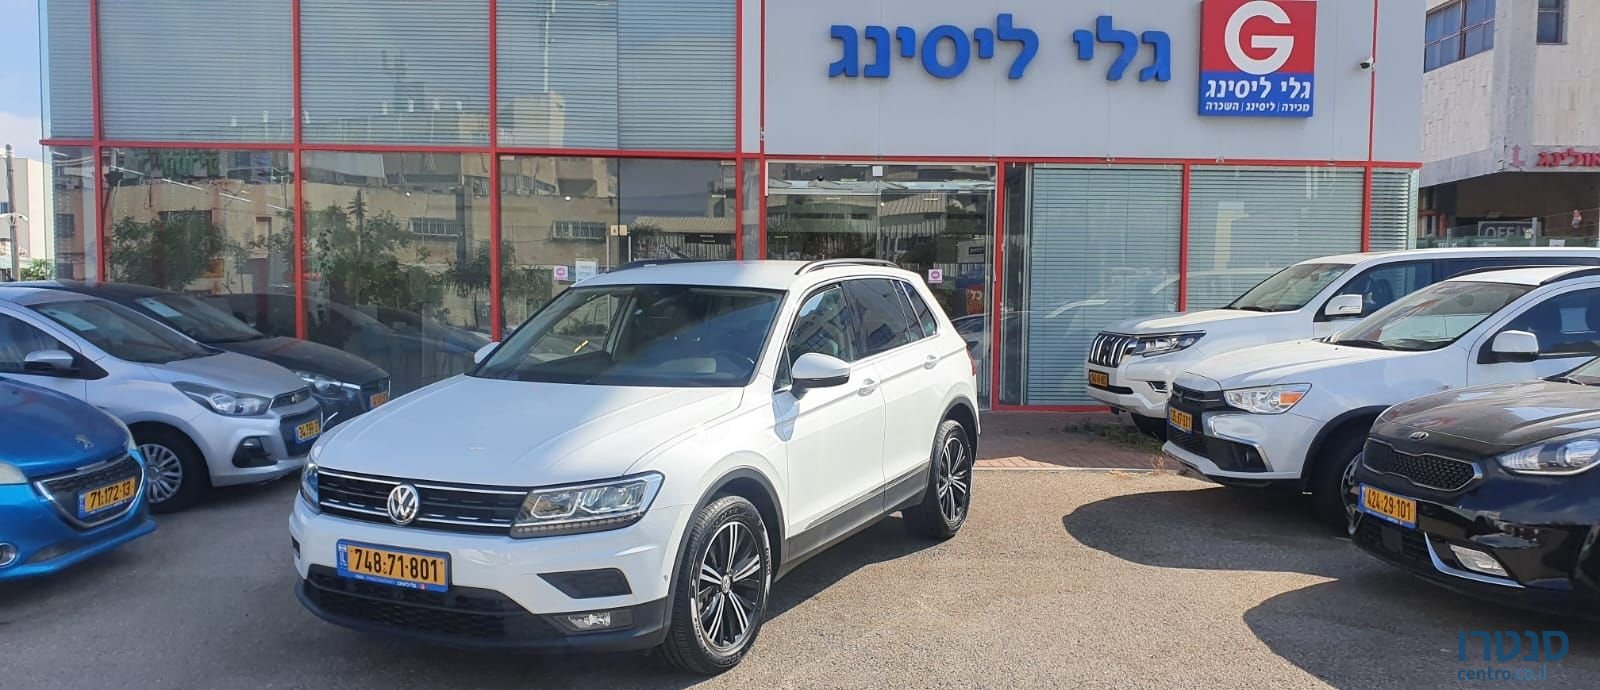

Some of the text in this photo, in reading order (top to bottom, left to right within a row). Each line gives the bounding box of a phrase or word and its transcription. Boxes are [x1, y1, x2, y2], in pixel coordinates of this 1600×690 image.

[828, 13, 1171, 82] גלי ליסינג
[1225, 0, 1294, 75] G
[1205, 76, 1311, 99] גלי ליסינג
[1205, 101, 1310, 112] מכירה ליסינג השכרה
